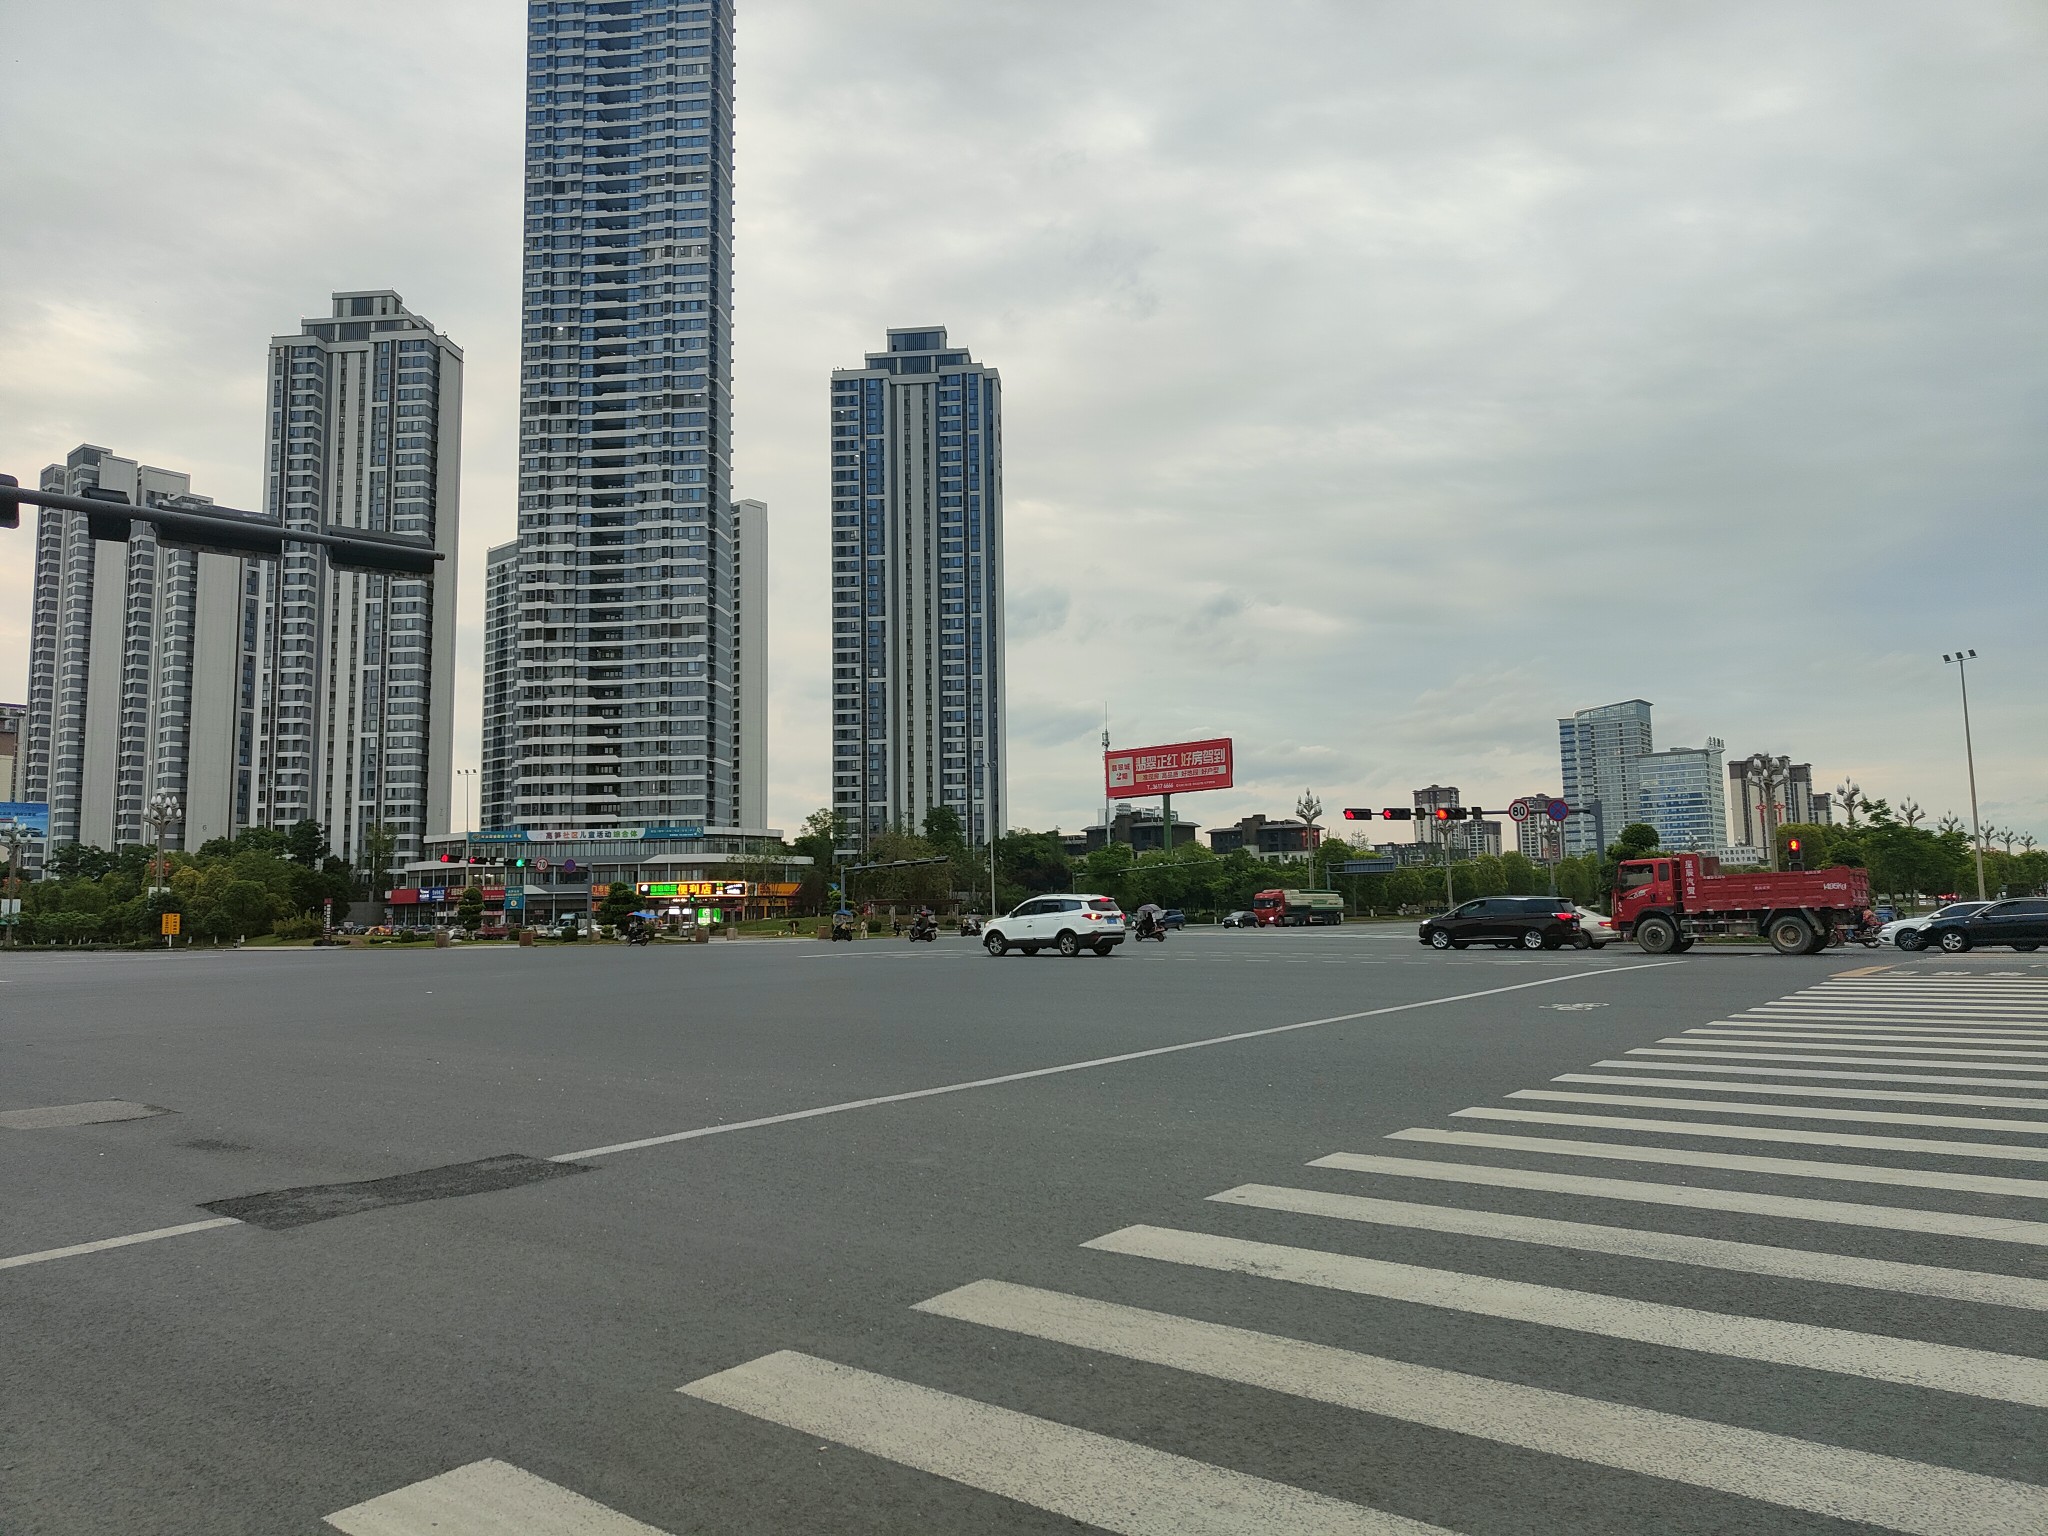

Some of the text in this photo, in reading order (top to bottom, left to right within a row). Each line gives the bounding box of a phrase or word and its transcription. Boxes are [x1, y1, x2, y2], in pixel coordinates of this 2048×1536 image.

[1136, 748, 1225, 771] 翡翠正红 好房驾到
[1513, 806, 1525, 816] 80
[538, 861, 546, 869] 70
[677, 883, 713, 896] 便利店
